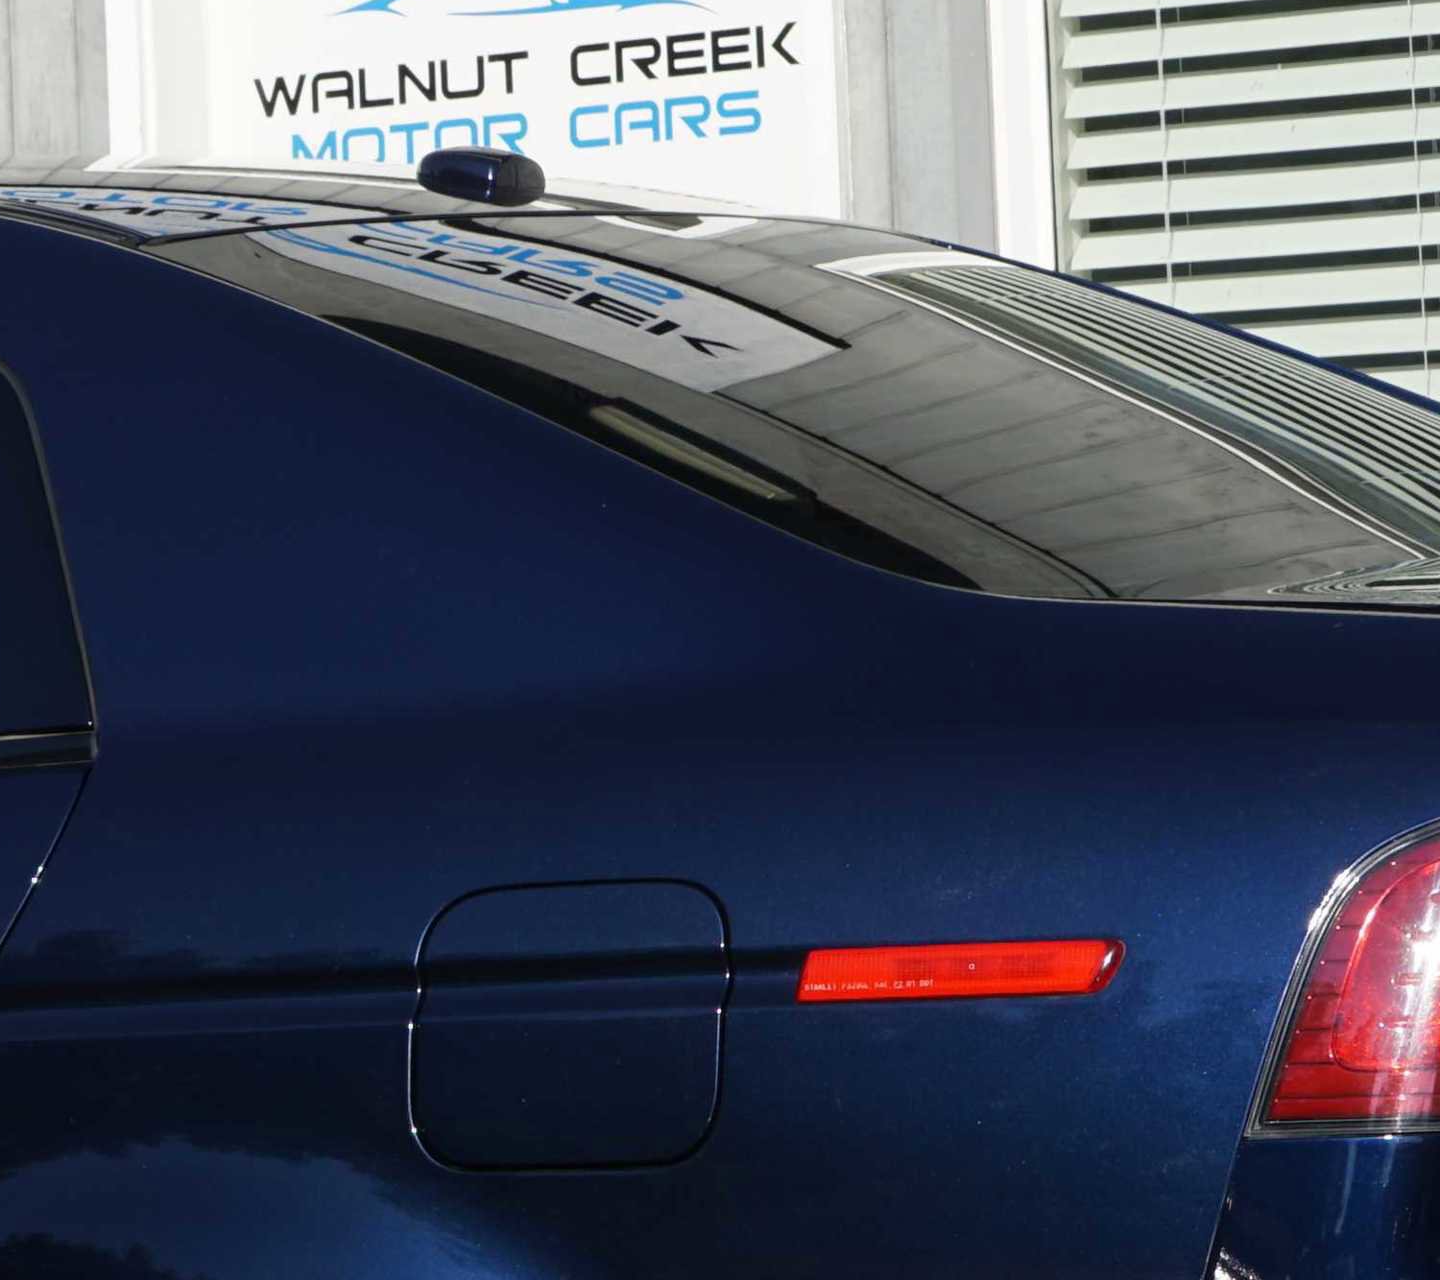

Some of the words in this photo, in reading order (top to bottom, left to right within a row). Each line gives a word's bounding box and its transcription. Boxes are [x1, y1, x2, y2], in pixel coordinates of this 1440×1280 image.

[254, 51, 528, 118] WALNUT
[571, 21, 800, 88] CREEK
[569, 89, 762, 149] CARS
